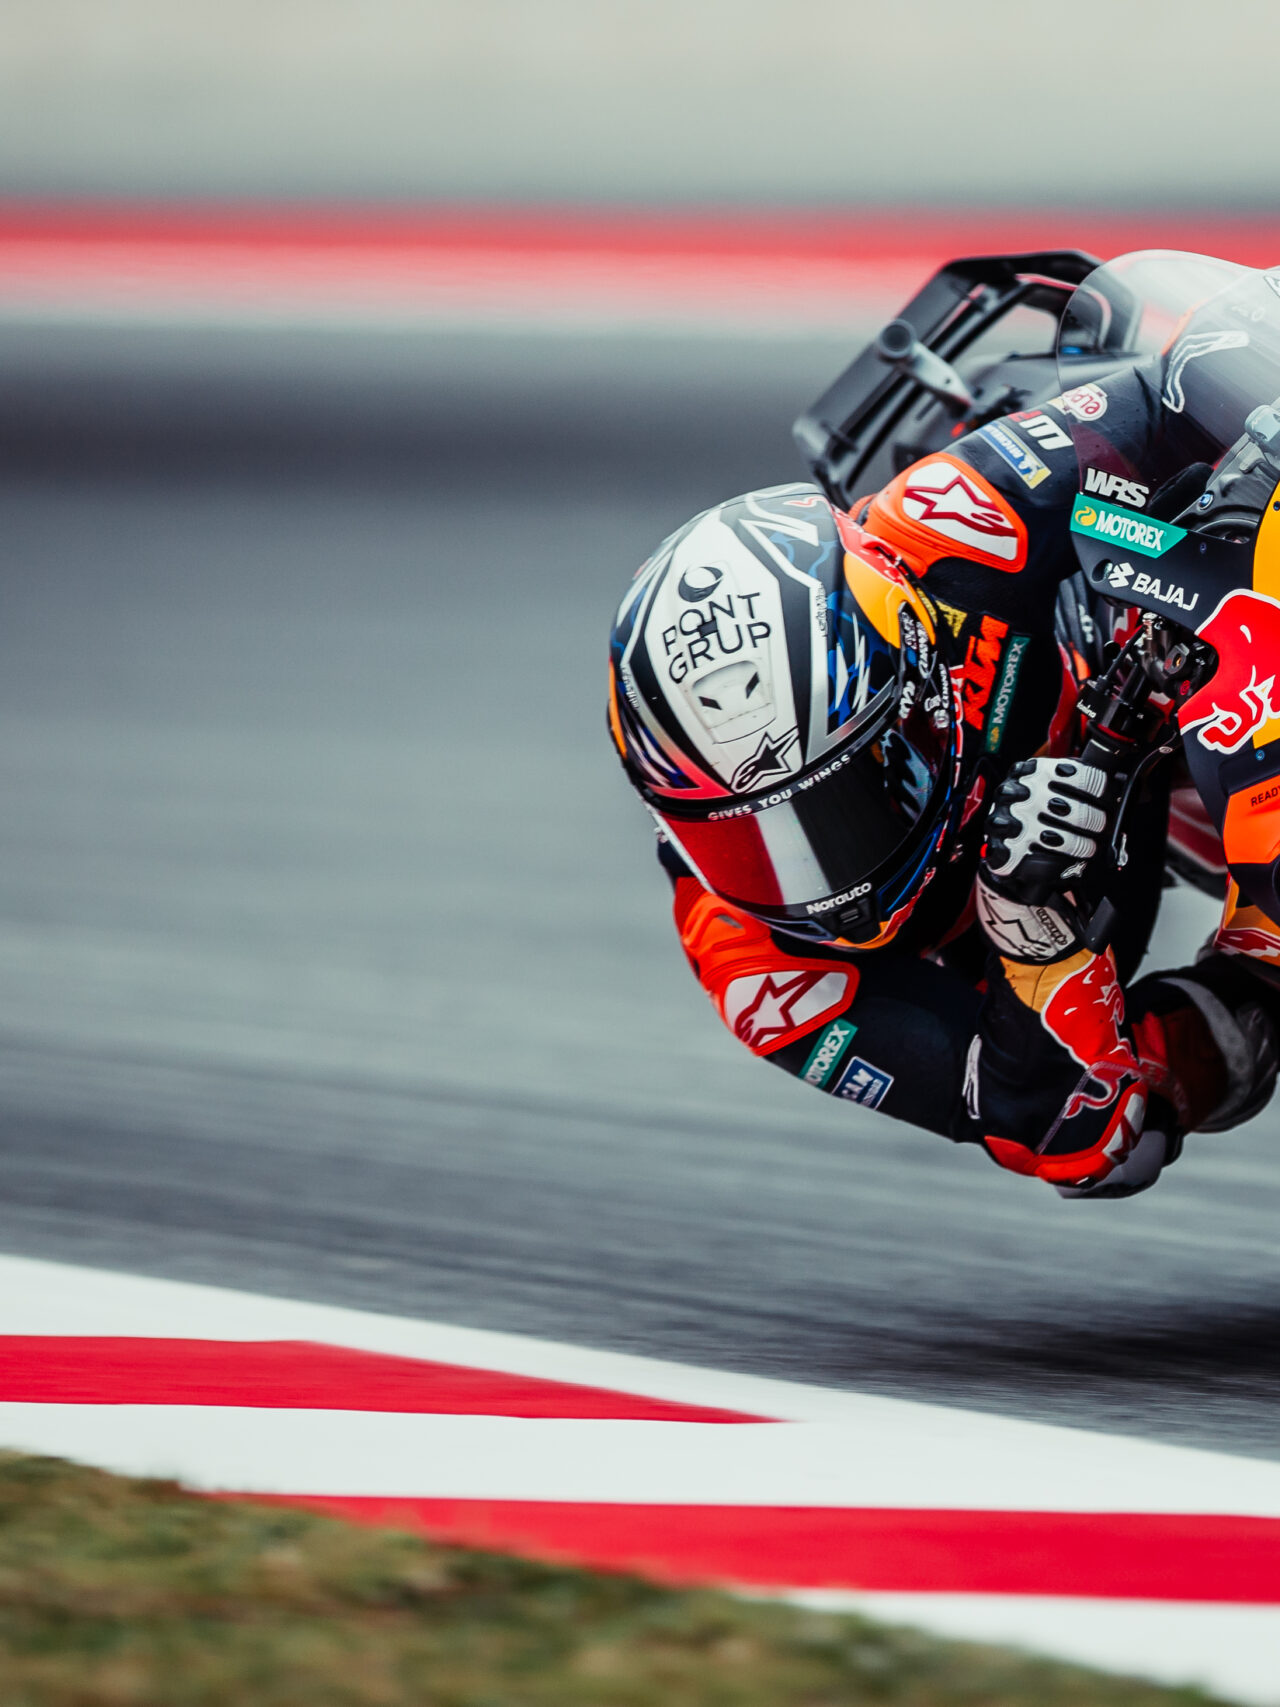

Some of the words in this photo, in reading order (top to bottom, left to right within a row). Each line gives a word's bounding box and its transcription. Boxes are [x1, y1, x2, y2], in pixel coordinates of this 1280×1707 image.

[1084, 467, 1150, 508] WRS
[1094, 510, 1165, 551] MOTOREX
[1131, 572, 1199, 611] BAJAJ
[662, 592, 760, 656] PONT
[669, 621, 771, 684] GRUP
[992, 641, 1025, 724] MOTOREX
[708, 804, 752, 821] GIVES
[758, 788, 793, 808] YOU
[798, 754, 850, 790] WINGS
[806, 881, 872, 915] Norauto
[803, 1023, 850, 1086] OTOREX
